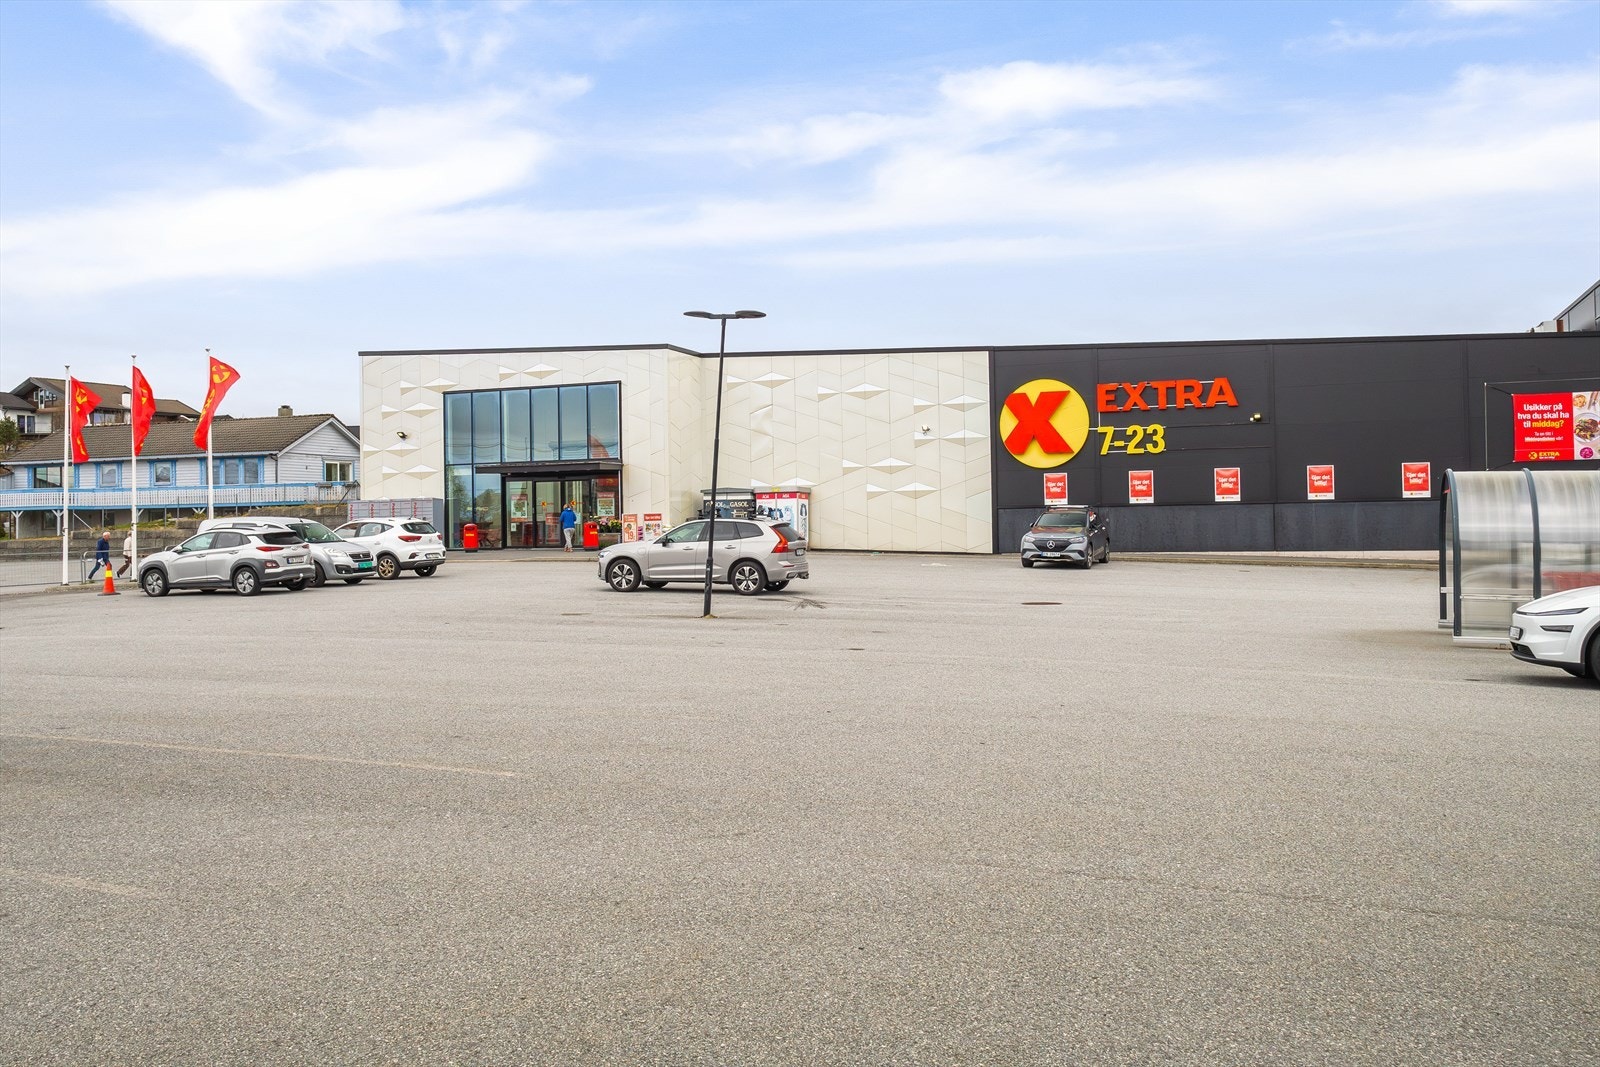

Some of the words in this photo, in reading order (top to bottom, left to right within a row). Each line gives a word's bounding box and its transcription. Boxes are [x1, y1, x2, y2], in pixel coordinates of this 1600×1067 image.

[1097, 377, 1239, 413] EXTRA
[1517, 412, 1531, 420] hva
[1543, 411, 1558, 419] skal
[1553, 402, 1563, 411] på
[1004, 390, 1075, 455] X
[1532, 420, 1564, 428] middag?
[1097, 423, 1166, 455] 7-23
